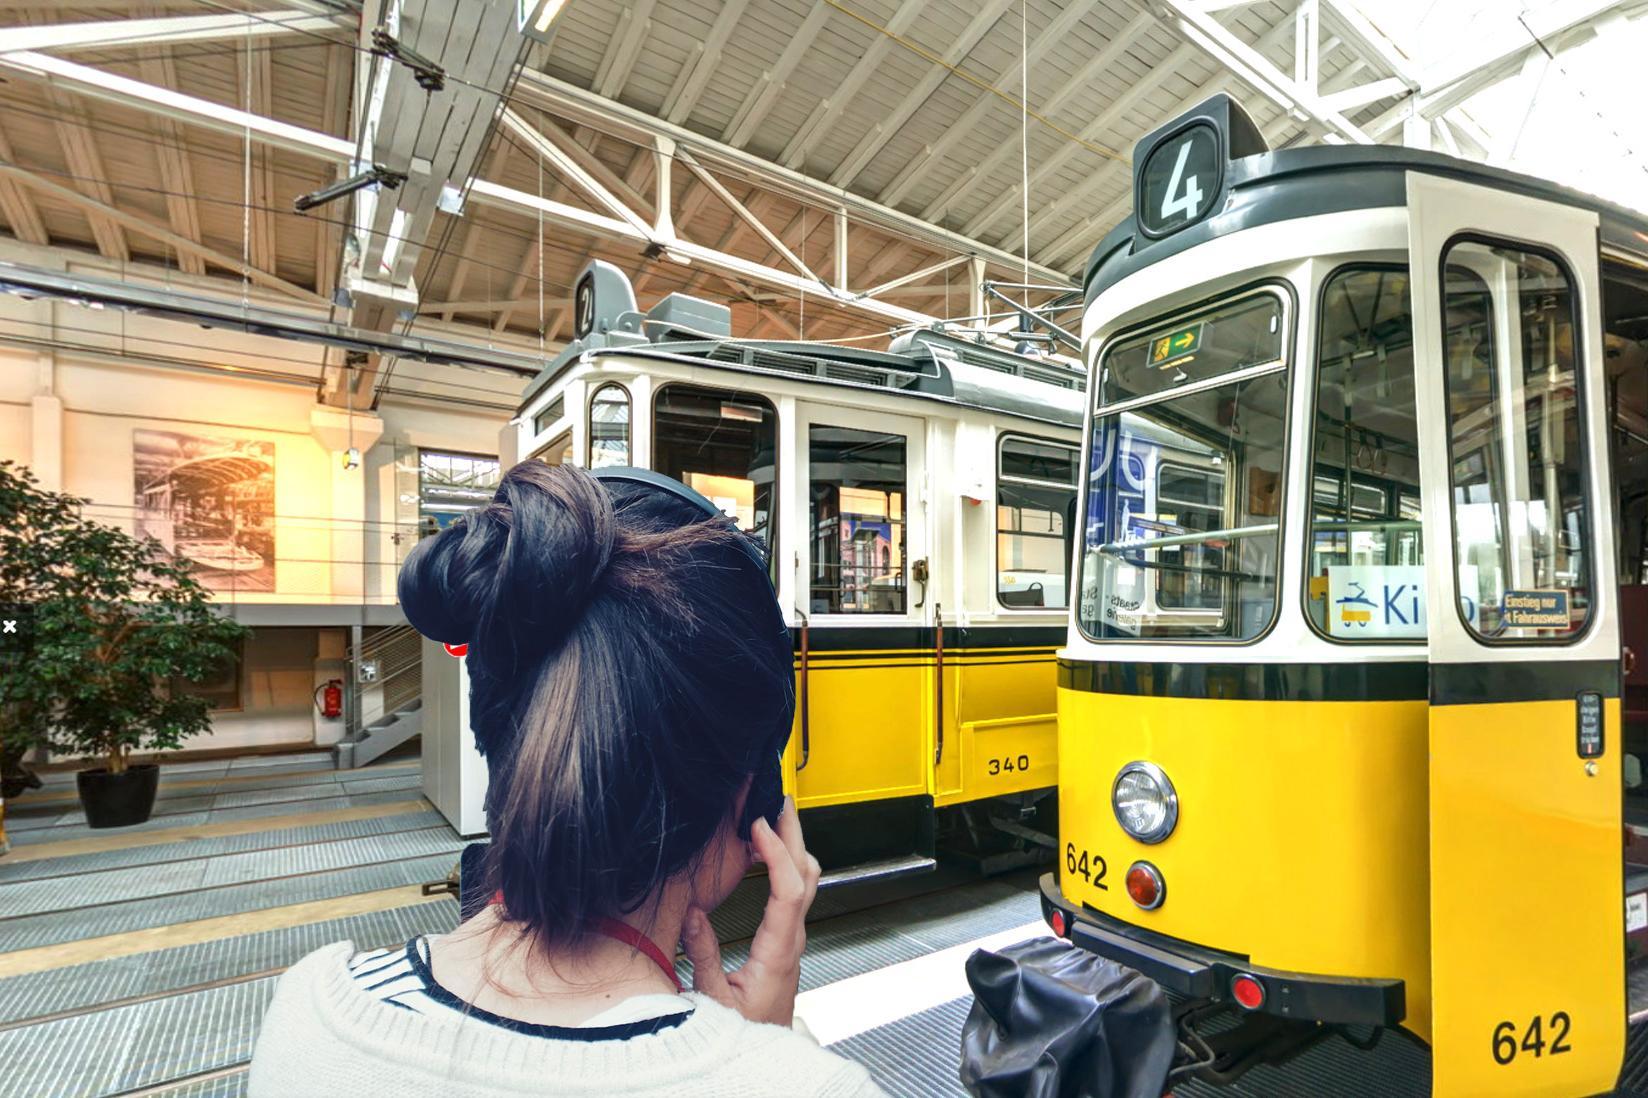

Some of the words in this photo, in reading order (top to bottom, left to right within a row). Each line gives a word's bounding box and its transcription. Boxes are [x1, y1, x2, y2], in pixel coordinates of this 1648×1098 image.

[1161, 140, 1203, 219] 4
[988, 754, 1029, 776] 340
[1066, 842, 1108, 891] 642
[1492, 1011, 1572, 1066] 642
